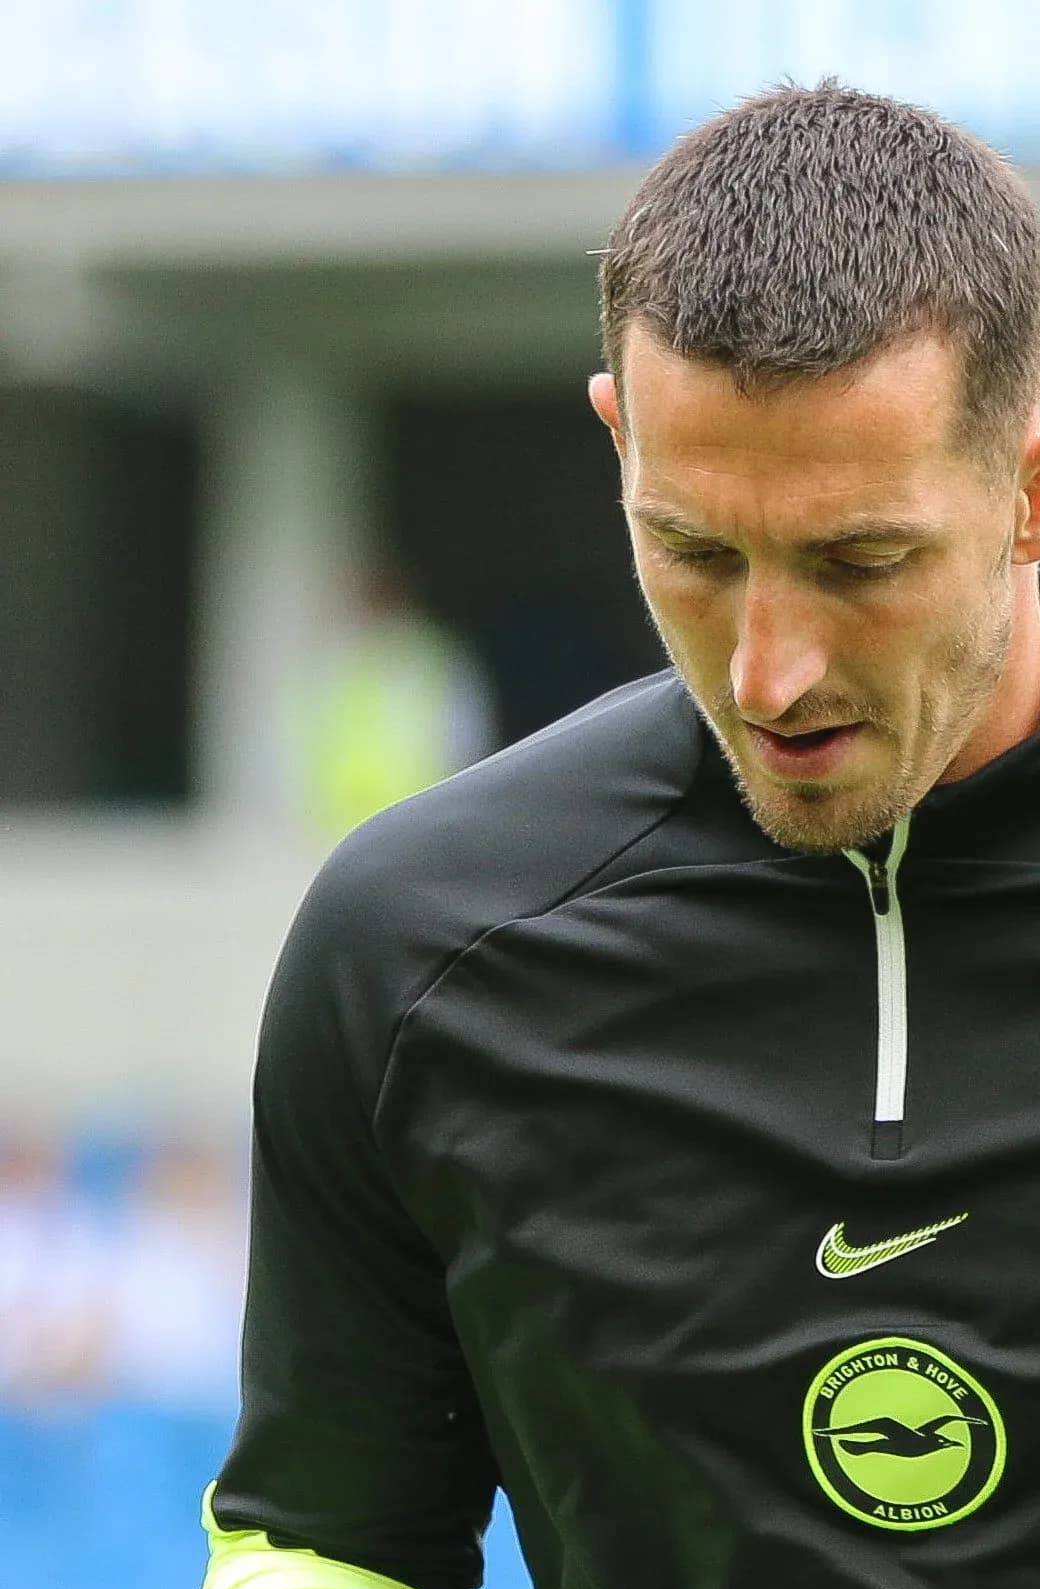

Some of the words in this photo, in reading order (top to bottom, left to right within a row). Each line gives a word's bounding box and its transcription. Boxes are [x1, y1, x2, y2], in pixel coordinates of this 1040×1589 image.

[820, 1353, 899, 1400] BRIGHTON
[906, 1356, 920, 1370] &
[926, 1363, 969, 1400] HOVE
[873, 1501, 949, 1521] ALBION
